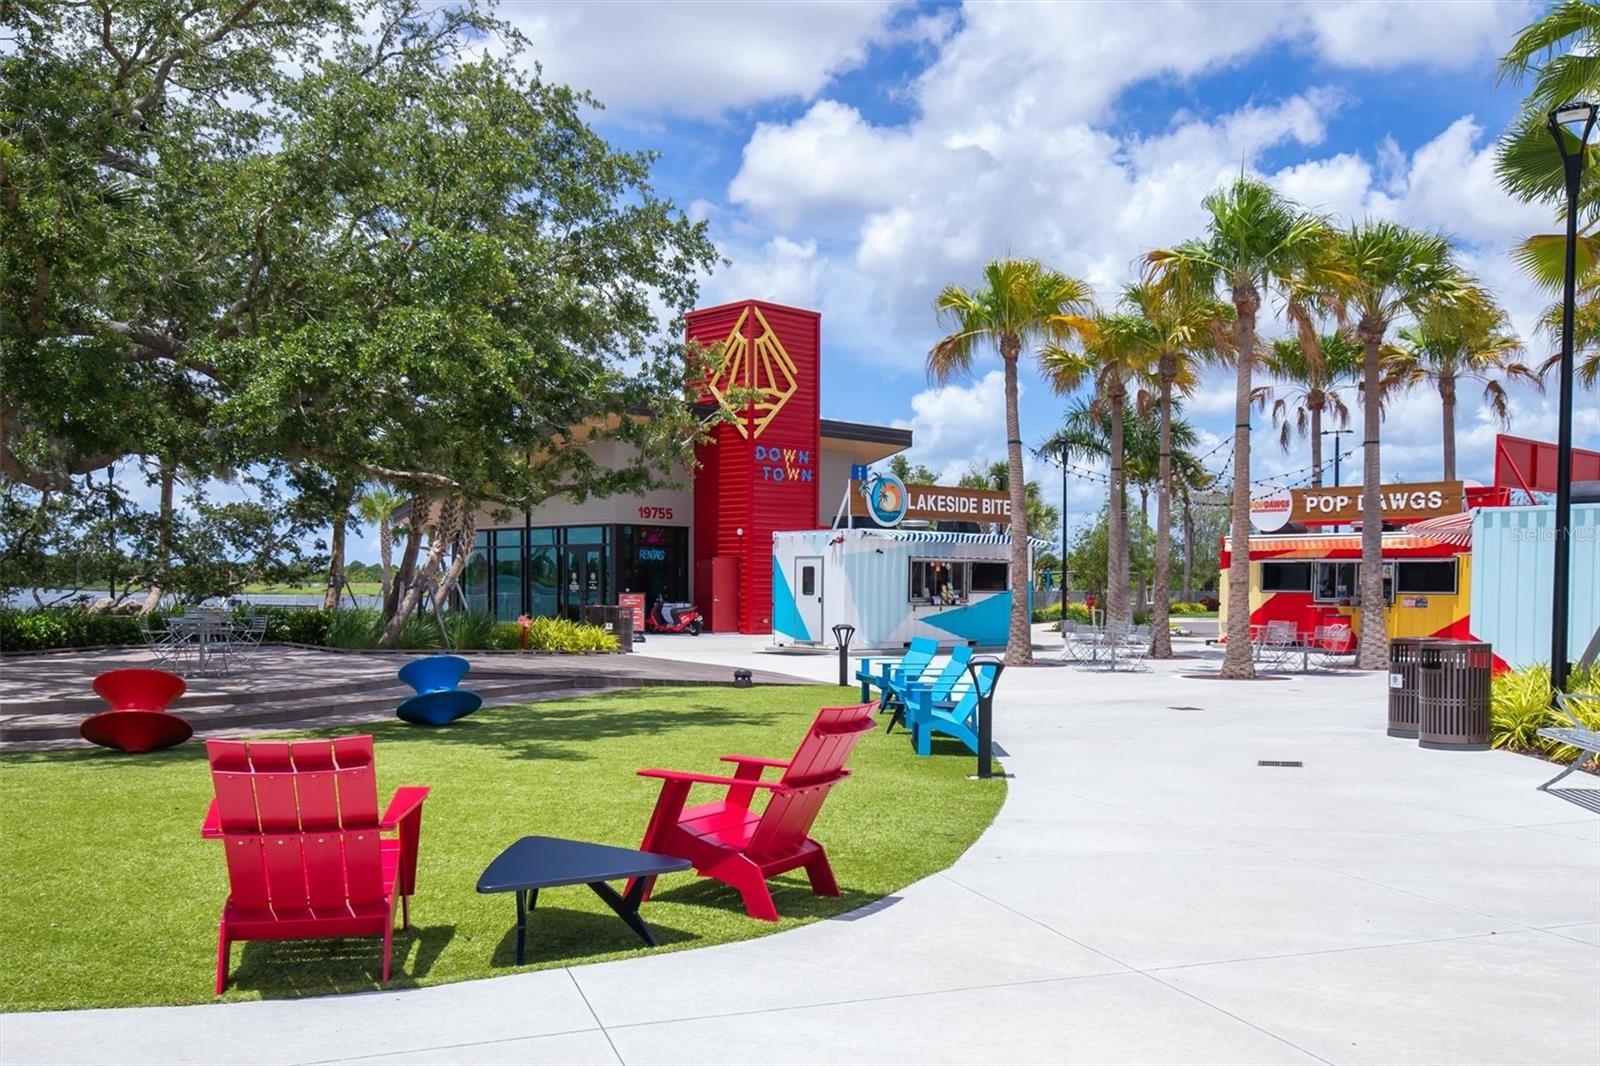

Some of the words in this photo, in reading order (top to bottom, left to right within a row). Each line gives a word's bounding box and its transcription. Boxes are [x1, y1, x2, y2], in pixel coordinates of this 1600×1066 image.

[755, 445, 809, 464] DOWN
[763, 465, 812, 482] TOWN
[907, 493, 978, 514] LAKESIDE
[1306, 495, 1350, 513] POP
[638, 506, 673, 520] 19755
